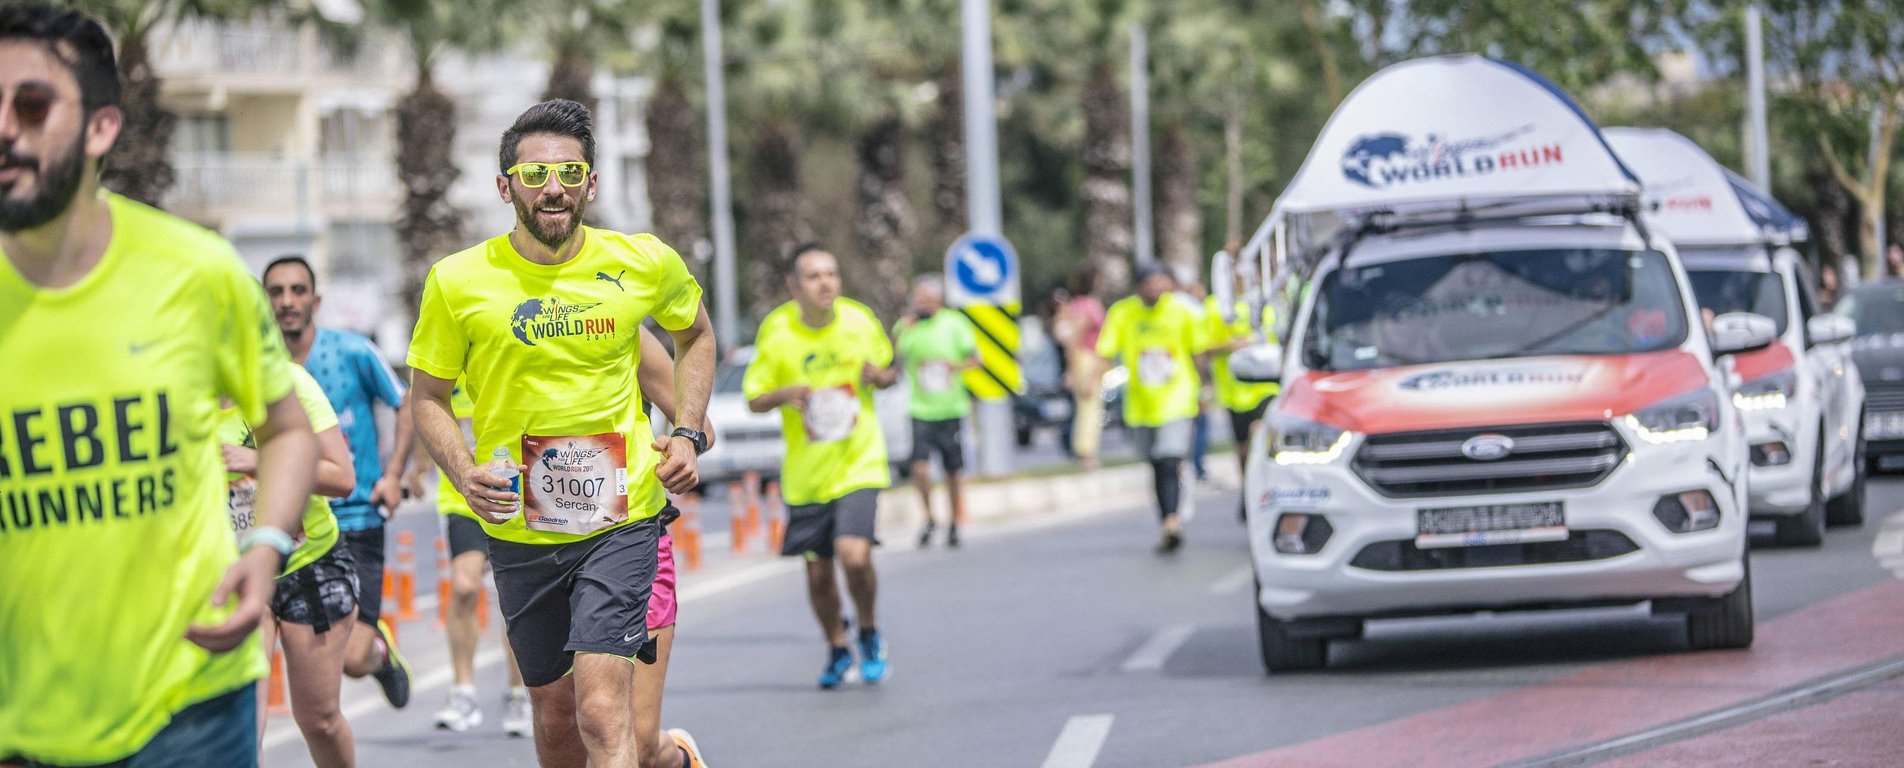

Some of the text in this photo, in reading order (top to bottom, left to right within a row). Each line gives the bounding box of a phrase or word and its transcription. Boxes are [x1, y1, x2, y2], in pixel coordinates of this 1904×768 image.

[1380, 156, 1495, 182] WORLD
[1499, 144, 1563, 170] RUN
[543, 304, 580, 315] WINGS
[550, 313, 569, 321] LIFE
[531, 317, 615, 340] WORLD RUN
[586, 333, 616, 341] 2017
[560, 450, 592, 459] WINGS
[564, 458, 583, 466] LIFE
[553, 464, 571, 473] WORLD
[542, 475, 605, 498] 31007
[619, 484, 625, 493] 3
[0, 468, 175, 532] UNNERS
[555, 497, 596, 512] Sercan
